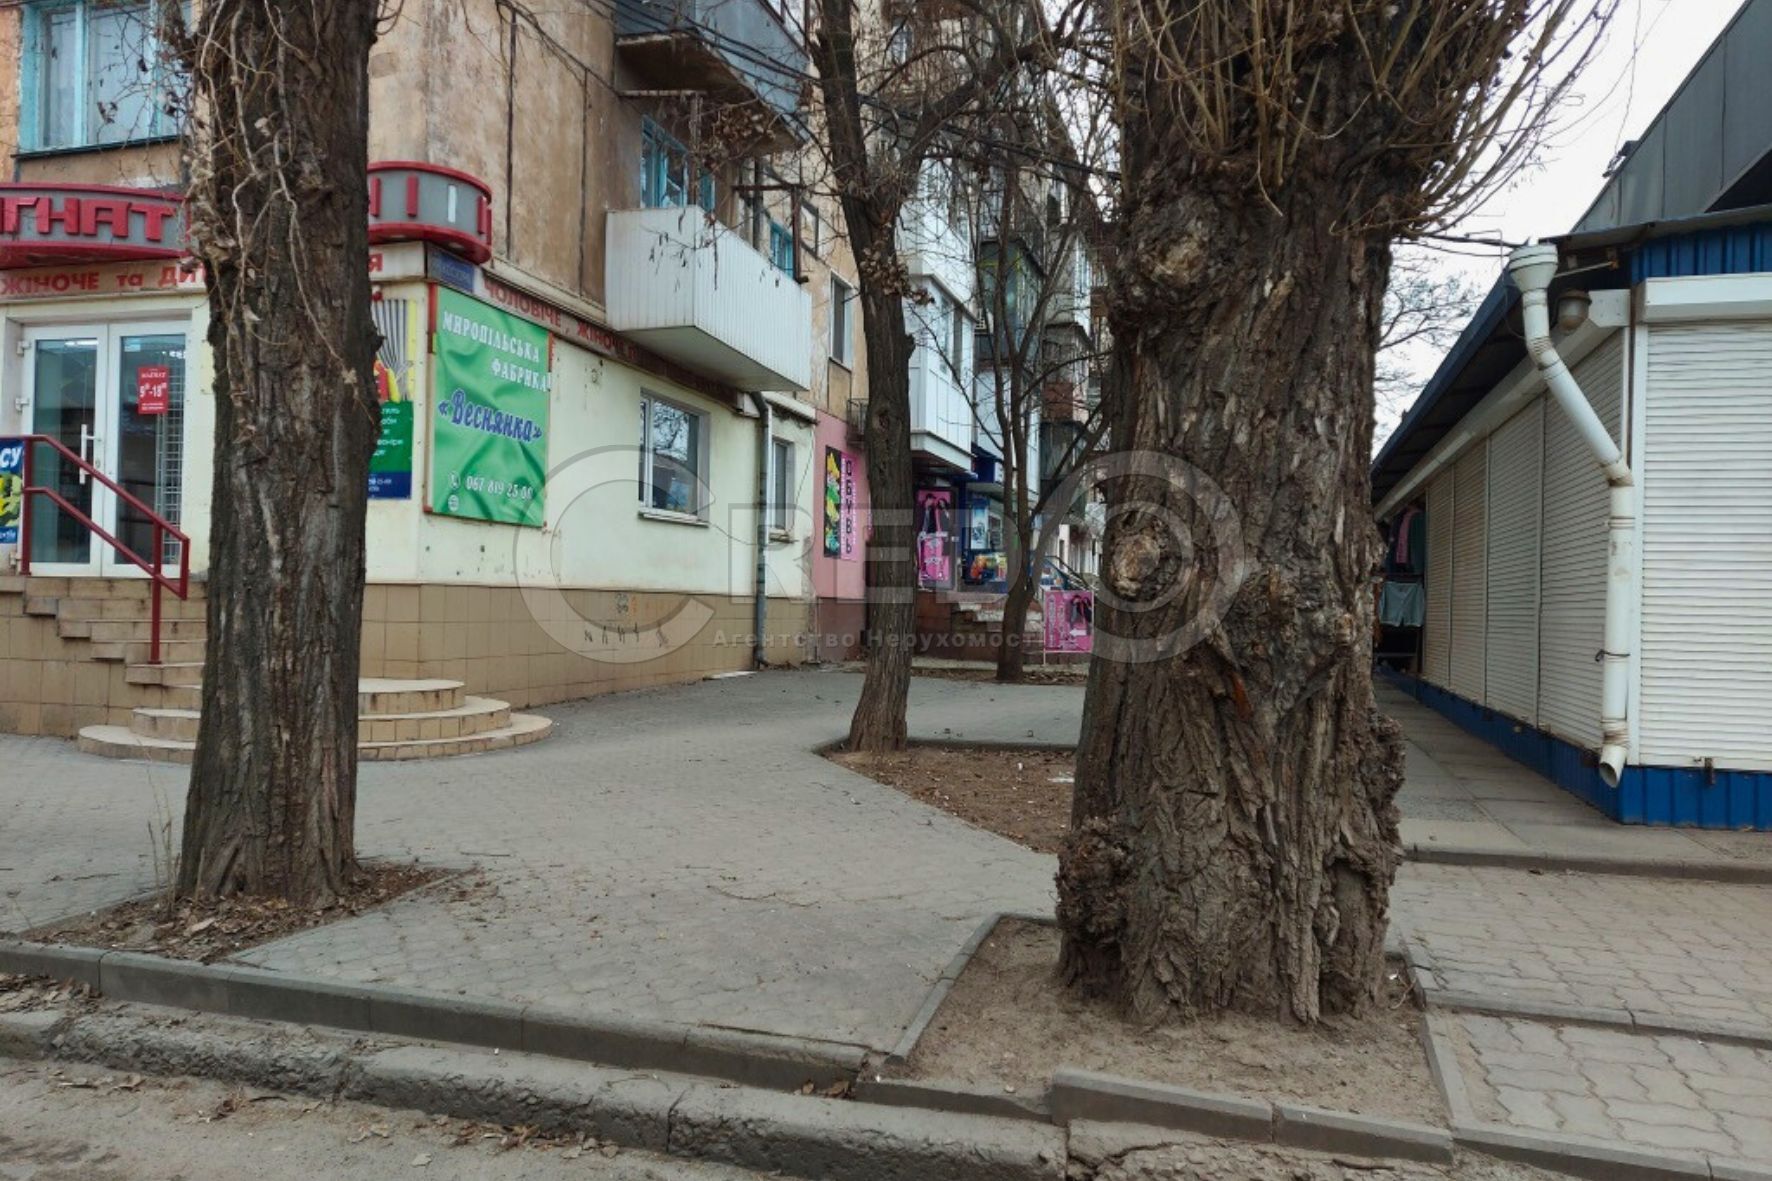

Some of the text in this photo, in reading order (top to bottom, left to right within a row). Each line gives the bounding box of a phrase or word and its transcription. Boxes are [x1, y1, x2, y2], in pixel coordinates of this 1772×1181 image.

[0, 196, 176, 242] ГНАТ
[1, 272, 100, 295] ЖІНОЧЕ
[116, 274, 144, 288] та
[442, 310, 540, 363] МИРОПІЛЬСЬКА
[490, 358, 546, 393] ФАБРИКА
